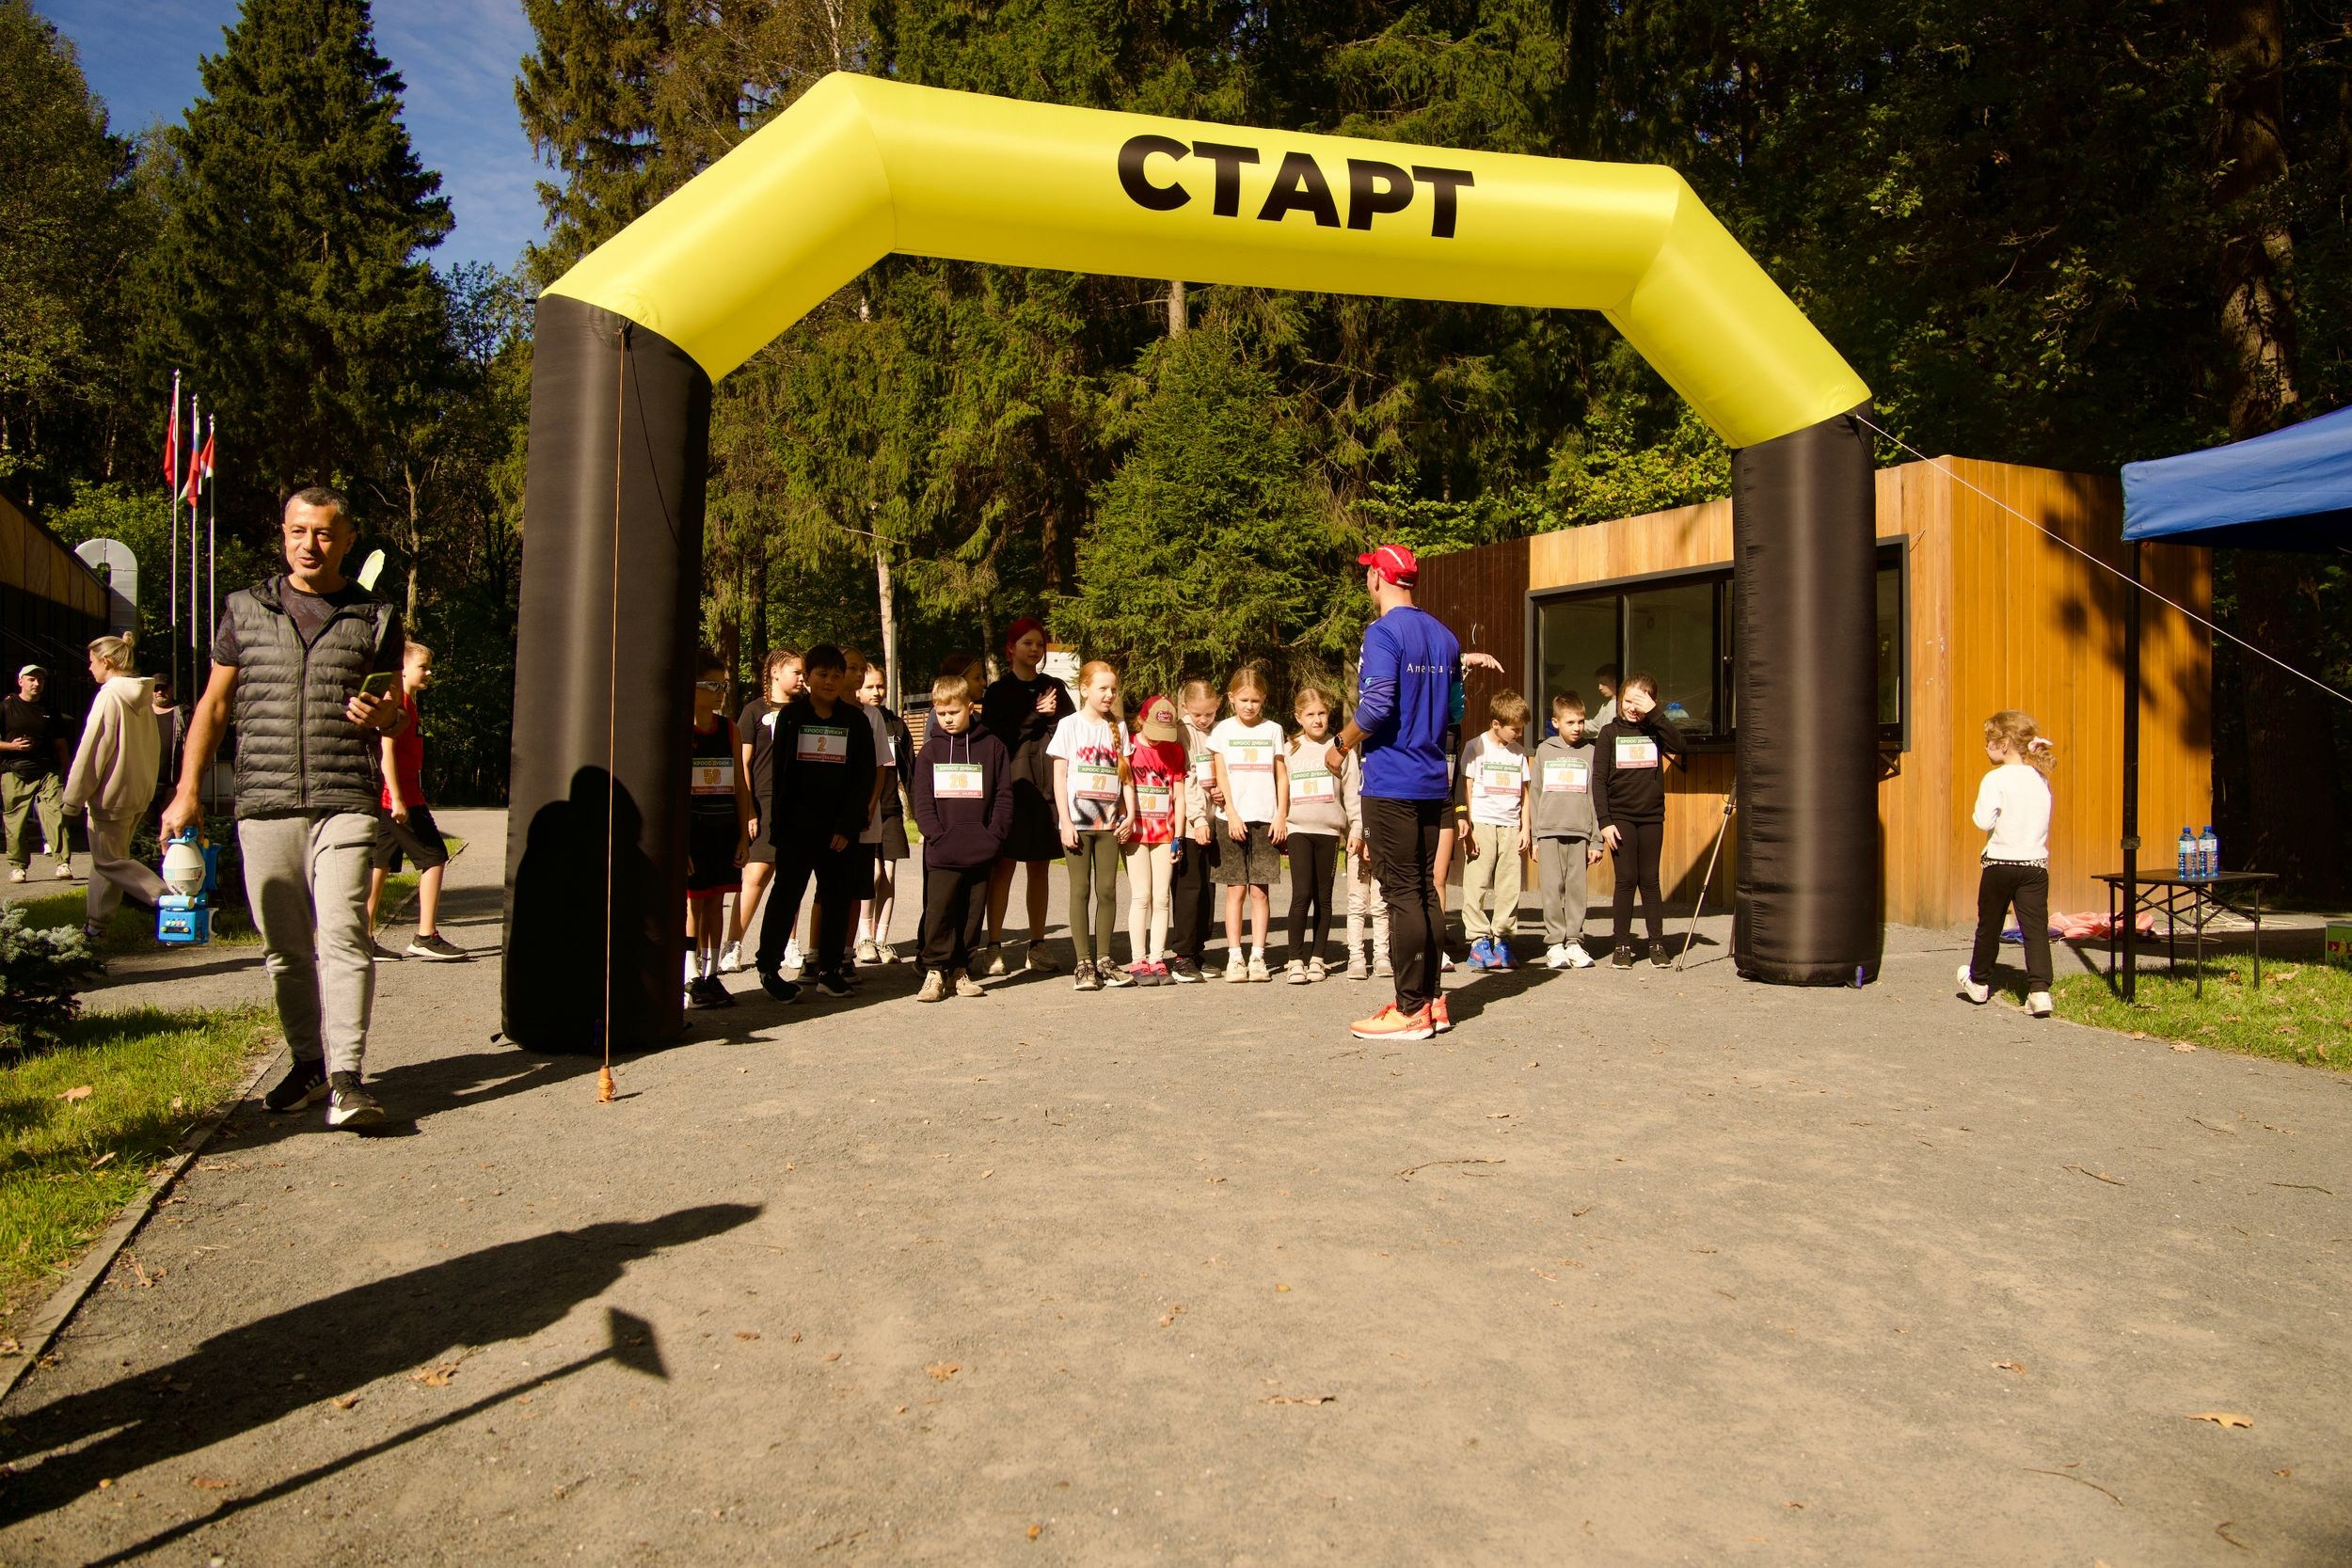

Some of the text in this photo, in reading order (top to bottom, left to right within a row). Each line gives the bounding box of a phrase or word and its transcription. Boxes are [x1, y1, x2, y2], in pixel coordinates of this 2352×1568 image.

[1118, 134, 1475, 239] СТАРТ
[817, 736, 828, 752] 2
[1091, 775, 1107, 790] 27
[1140, 795, 1156, 811] 28
[1406, 1018, 1423, 1030] HOKA
